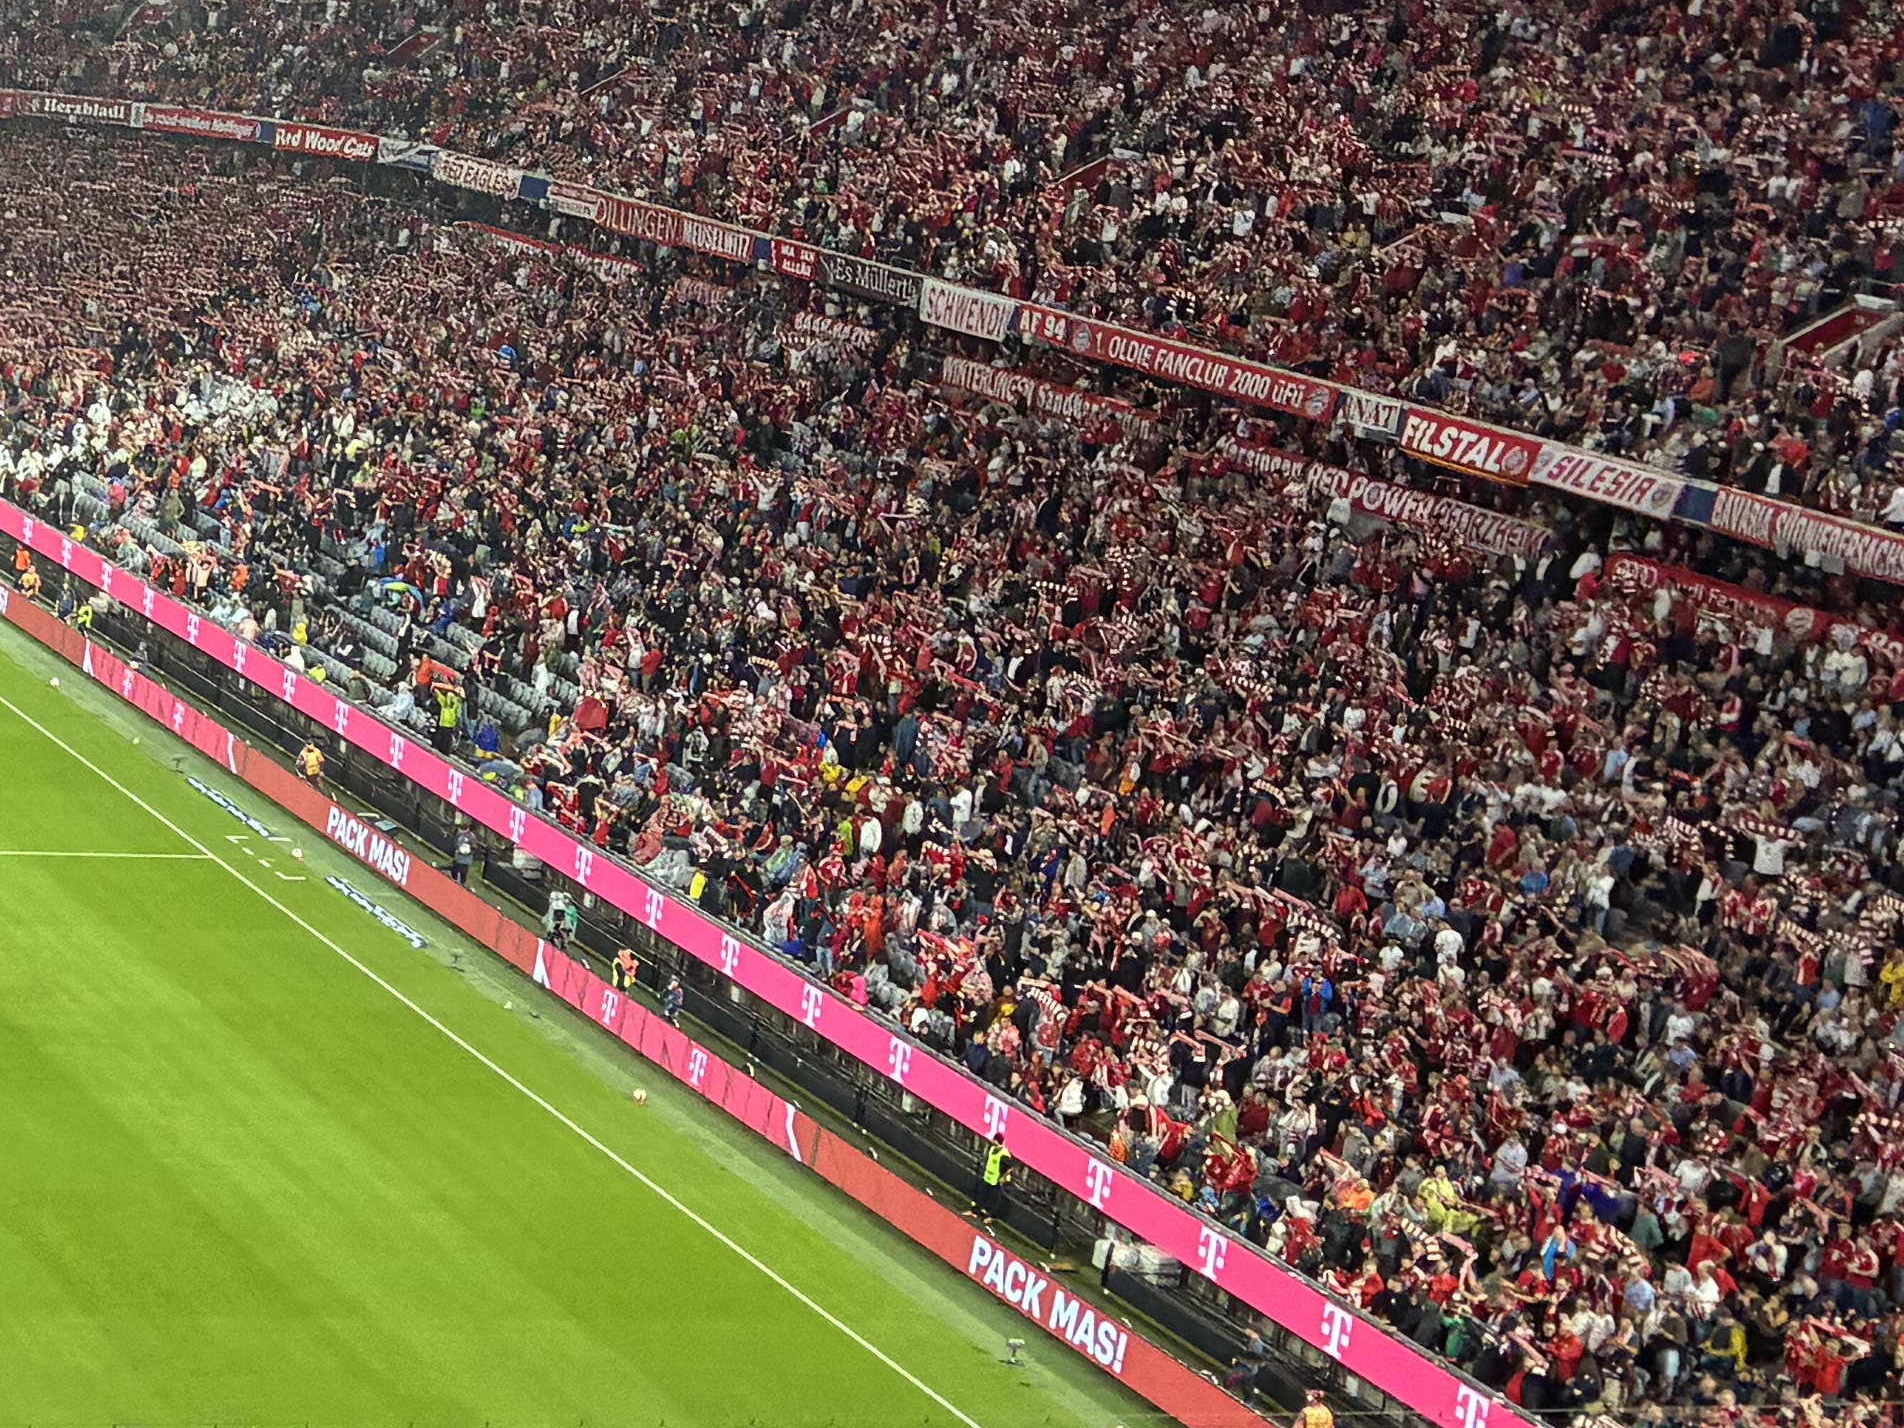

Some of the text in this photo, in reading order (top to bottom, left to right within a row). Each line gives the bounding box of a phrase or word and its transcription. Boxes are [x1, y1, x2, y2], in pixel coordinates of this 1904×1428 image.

[594, 197, 677, 242] DILLINGEN
[1045, 315, 1067, 341] 94
[1108, 335, 1155, 370] OLDIE
[1154, 348, 1229, 388] FANCLUB
[1228, 369, 1271, 401] 2000
[1402, 415, 1505, 473] FILSTAL
[1547, 455, 1657, 505] SILESIA
[328, 802, 367, 861] PACK
[969, 1235, 1129, 1376] PACK MAS!
